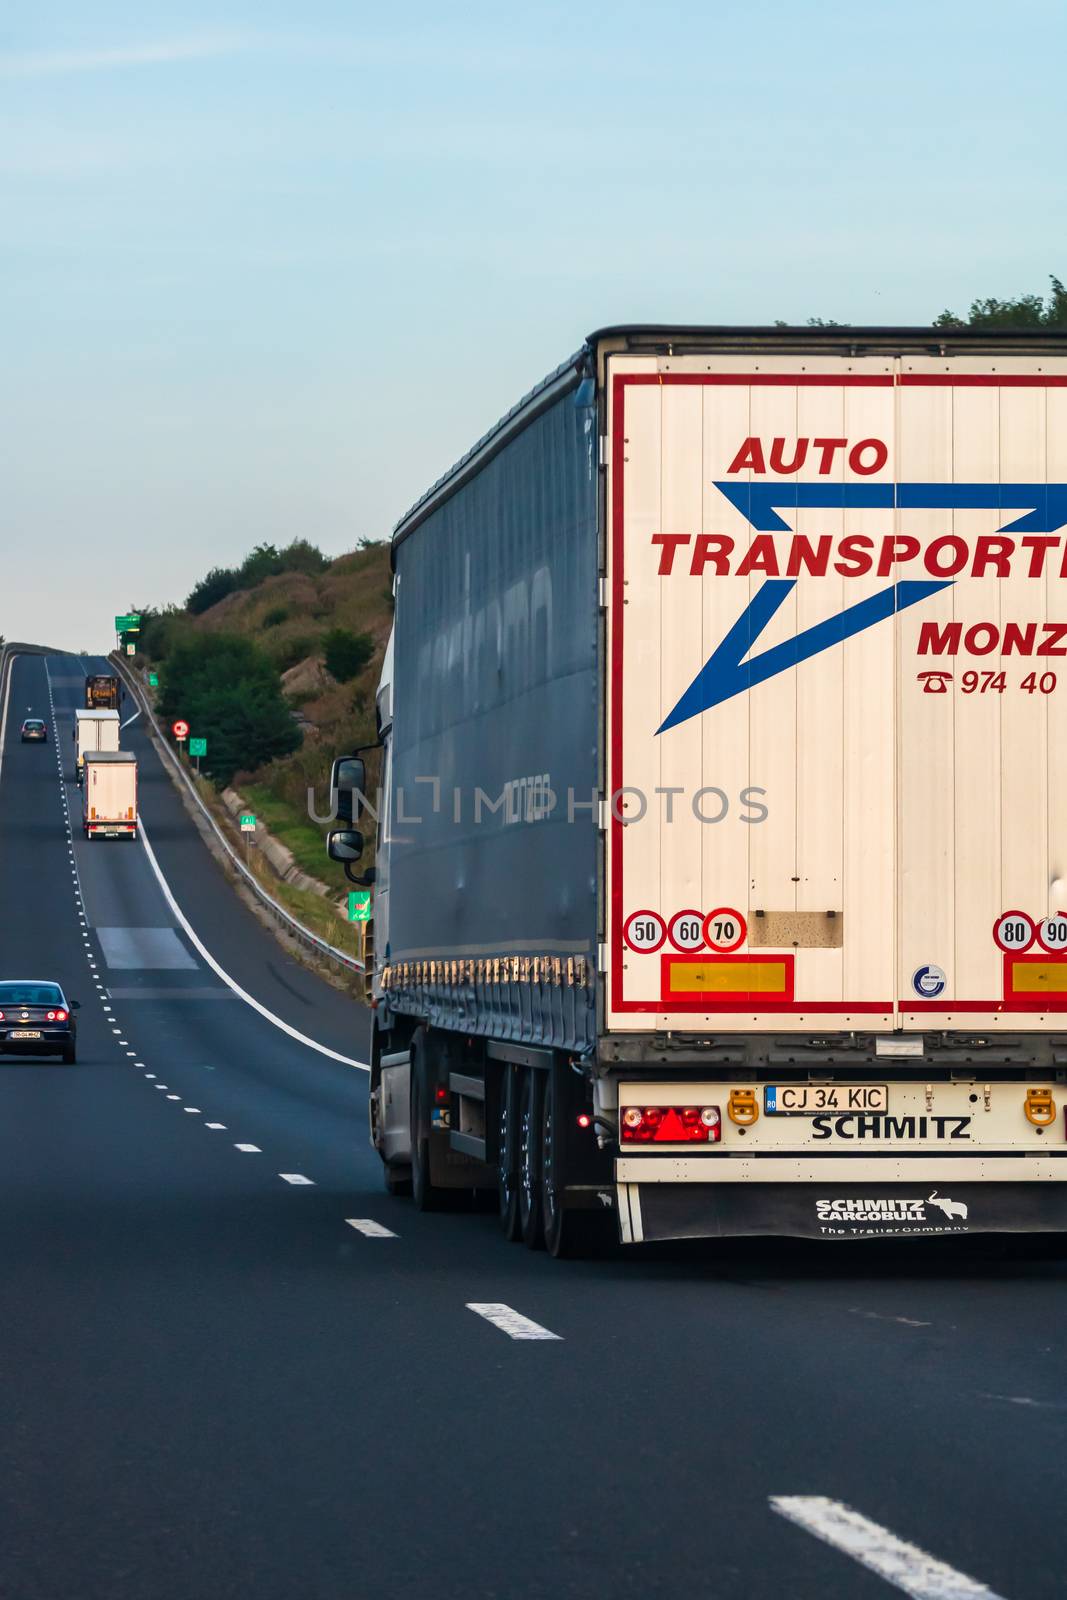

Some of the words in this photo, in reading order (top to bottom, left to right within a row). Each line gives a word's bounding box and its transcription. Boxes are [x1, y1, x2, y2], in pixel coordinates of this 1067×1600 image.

[727, 437, 889, 475] AUTO
[916, 622, 1067, 656] MONZ
[961, 671, 1007, 694] 974
[1020, 671, 1057, 695] 40
[635, 921, 656, 941] 50
[680, 921, 700, 941] 60
[714, 921, 735, 941] 70
[1004, 922, 1025, 942] 80
[1047, 922, 1067, 942] 90
[766, 1100, 776, 1109] RO
[782, 1089, 807, 1108] CJ
[815, 1089, 839, 1108] 34
[848, 1089, 882, 1108] KIC
[812, 1116, 972, 1139] SCHMITZ
[815, 1200, 925, 1212] SCHMITZ
[817, 1211, 927, 1221] CARGOBULL
[820, 1226, 846, 1235] The
